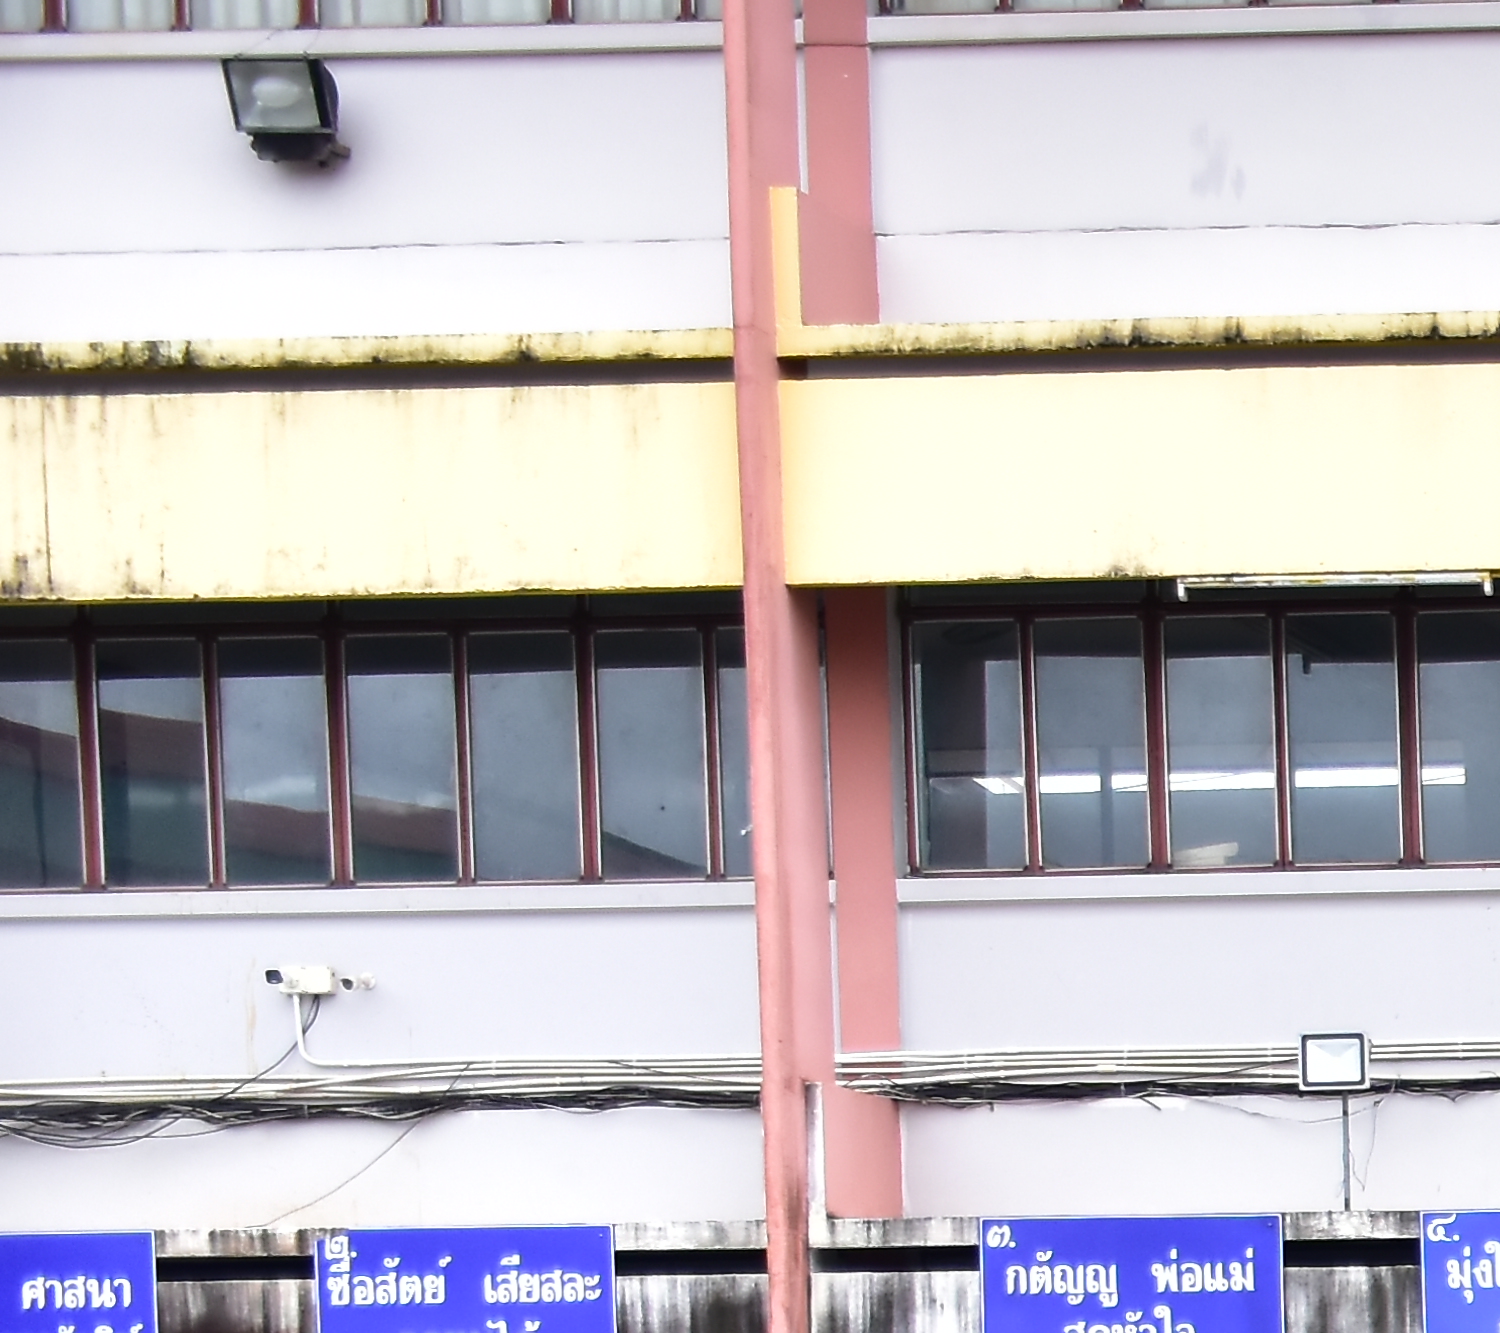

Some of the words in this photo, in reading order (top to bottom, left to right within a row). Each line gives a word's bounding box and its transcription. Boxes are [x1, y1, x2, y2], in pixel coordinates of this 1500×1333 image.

[22, 1276, 131, 1309] ศาสนา
[324, 1252, 451, 1305] ซื่อสัตย์
[484, 1254, 602, 1303] เสียสละ
[1006, 1251, 1118, 1307] กตัญญู
[1151, 1248, 1254, 1293] พ่อแม่
